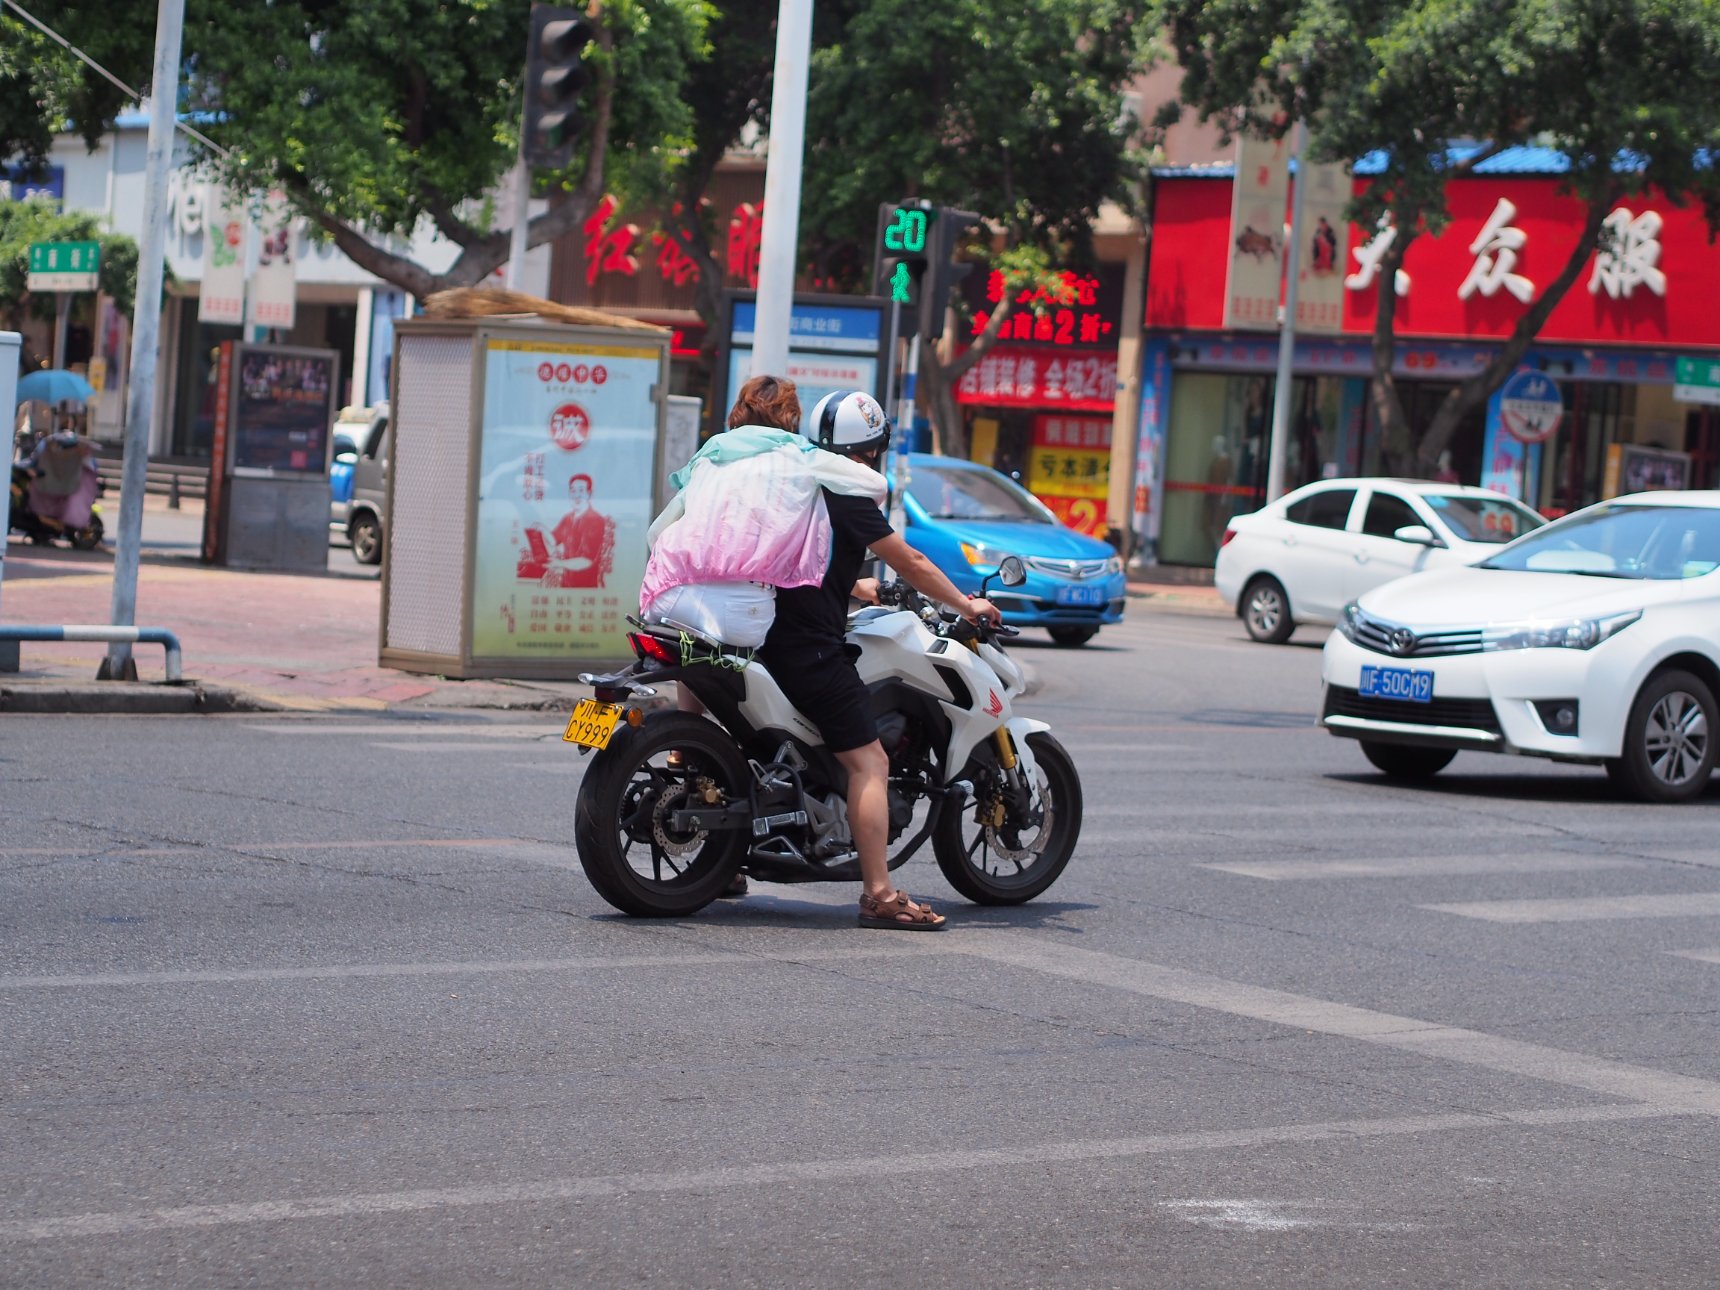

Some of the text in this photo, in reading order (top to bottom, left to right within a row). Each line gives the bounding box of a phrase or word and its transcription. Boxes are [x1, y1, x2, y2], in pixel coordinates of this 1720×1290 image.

[885, 208, 927, 251] 20
[552, 412, 585, 445] 诚
[566, 719, 610, 746] CY999
